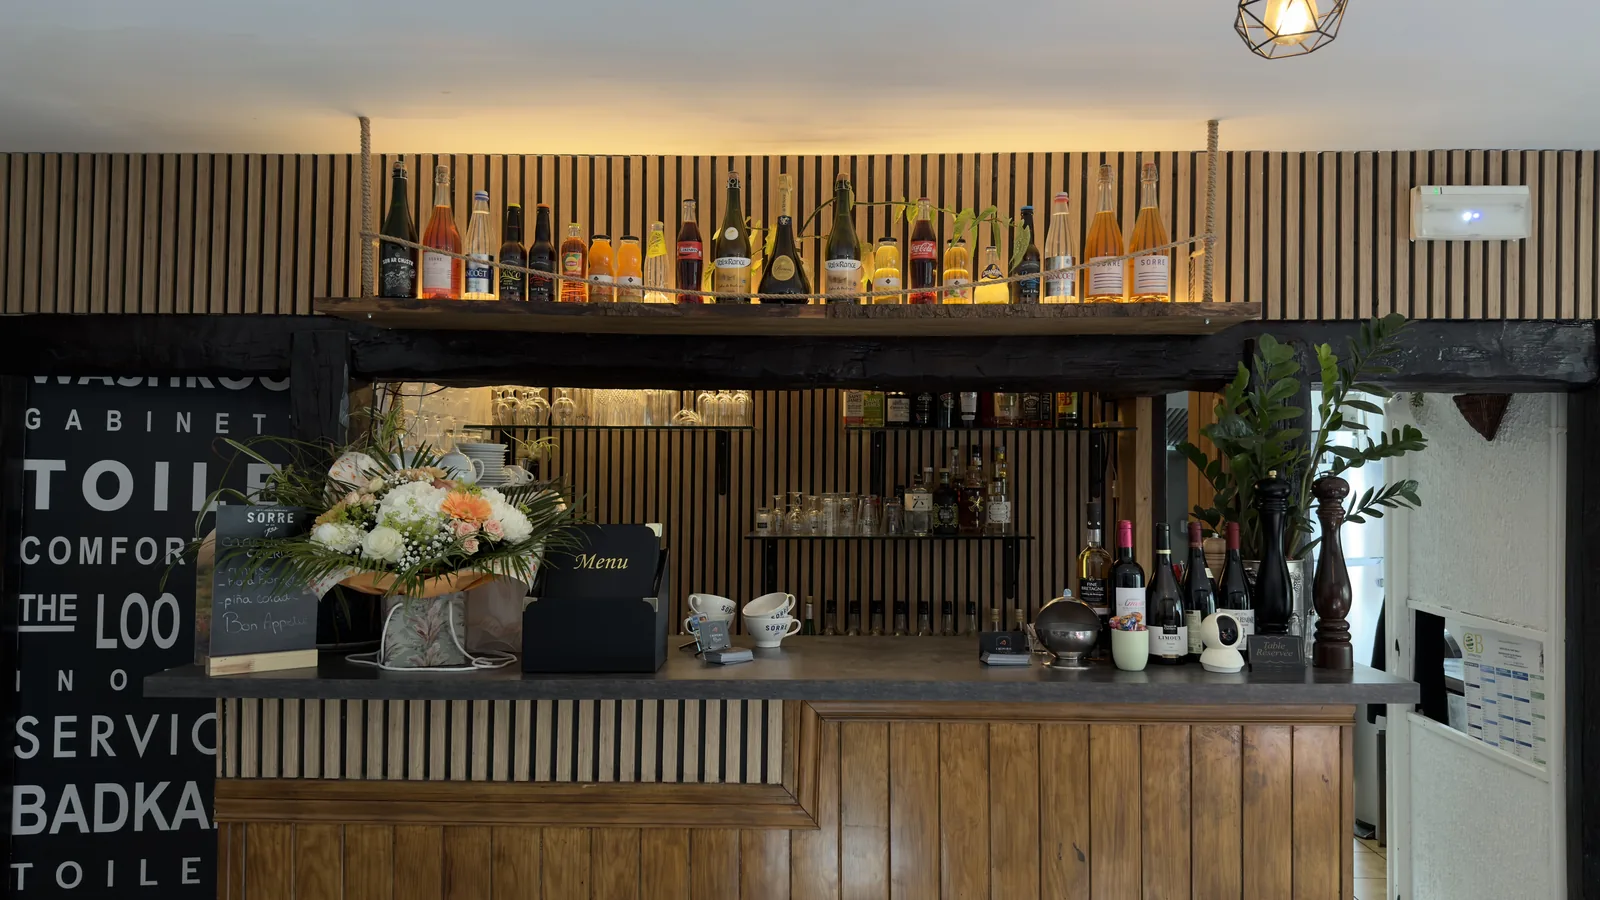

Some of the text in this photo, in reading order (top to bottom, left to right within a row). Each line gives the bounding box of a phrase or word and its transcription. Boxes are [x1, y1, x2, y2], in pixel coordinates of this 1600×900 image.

[25, 408, 291, 434] GABINET
[247, 512, 295, 524] SORRE
[20, 535, 203, 565] COMFOR
[573, 553, 628, 570] Menu
[19, 593, 181, 649] THE LOO
[1263, 641, 1286, 650] Table
[15, 668, 172, 691] INO
[11, 780, 219, 835] BADKA
[10, 857, 201, 890] TOILE
